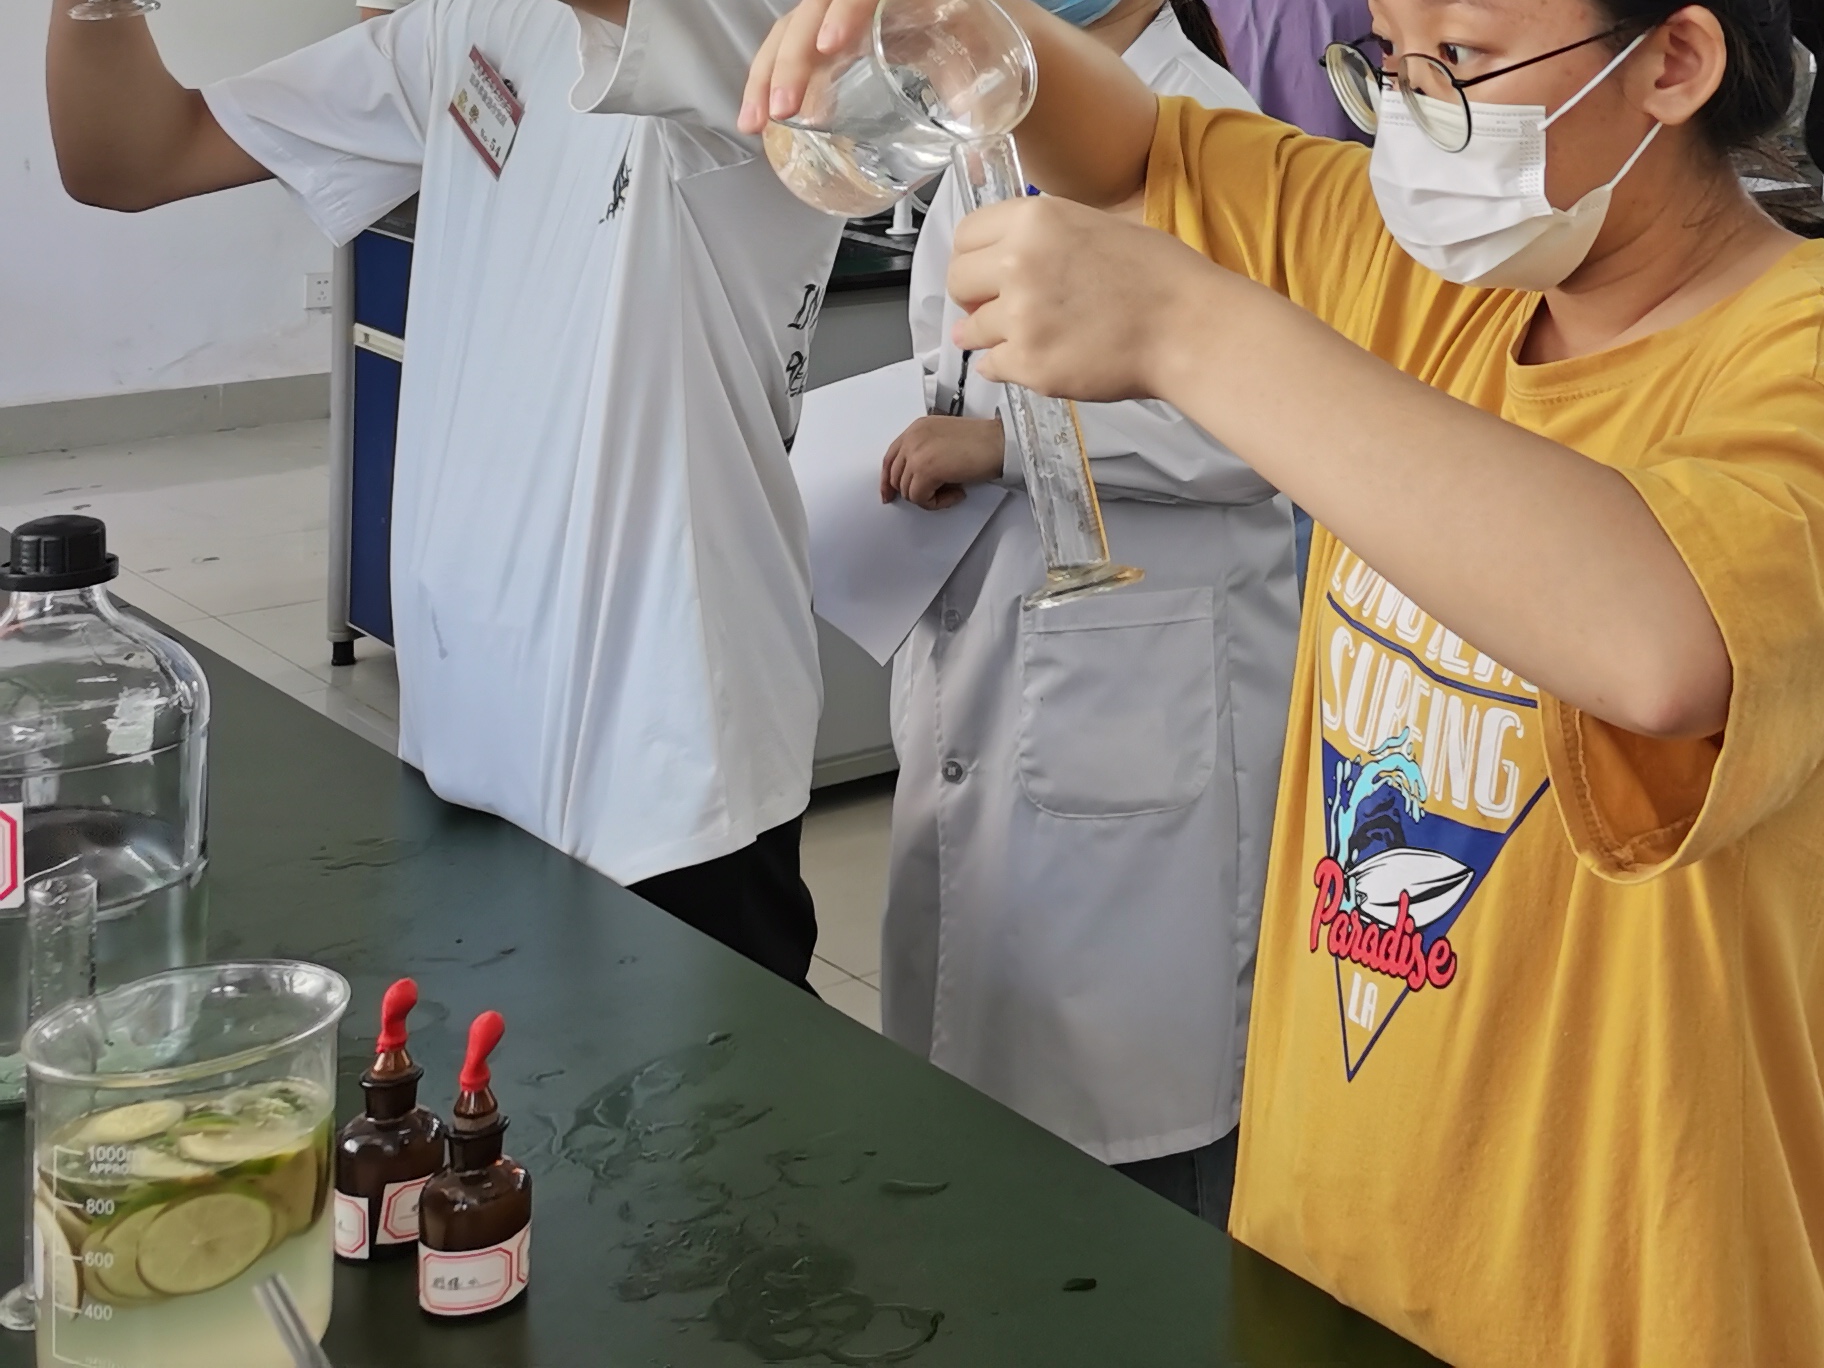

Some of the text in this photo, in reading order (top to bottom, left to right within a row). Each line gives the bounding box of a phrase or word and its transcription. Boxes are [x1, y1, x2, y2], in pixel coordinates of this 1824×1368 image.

[1322, 625, 1524, 818] SURFING
[1310, 855, 1458, 992] Paradise
[1347, 972, 1379, 1032] LA
[85, 1198, 115, 1215] 800
[84, 1251, 114, 1268] 600
[84, 1303, 113, 1321] 400
